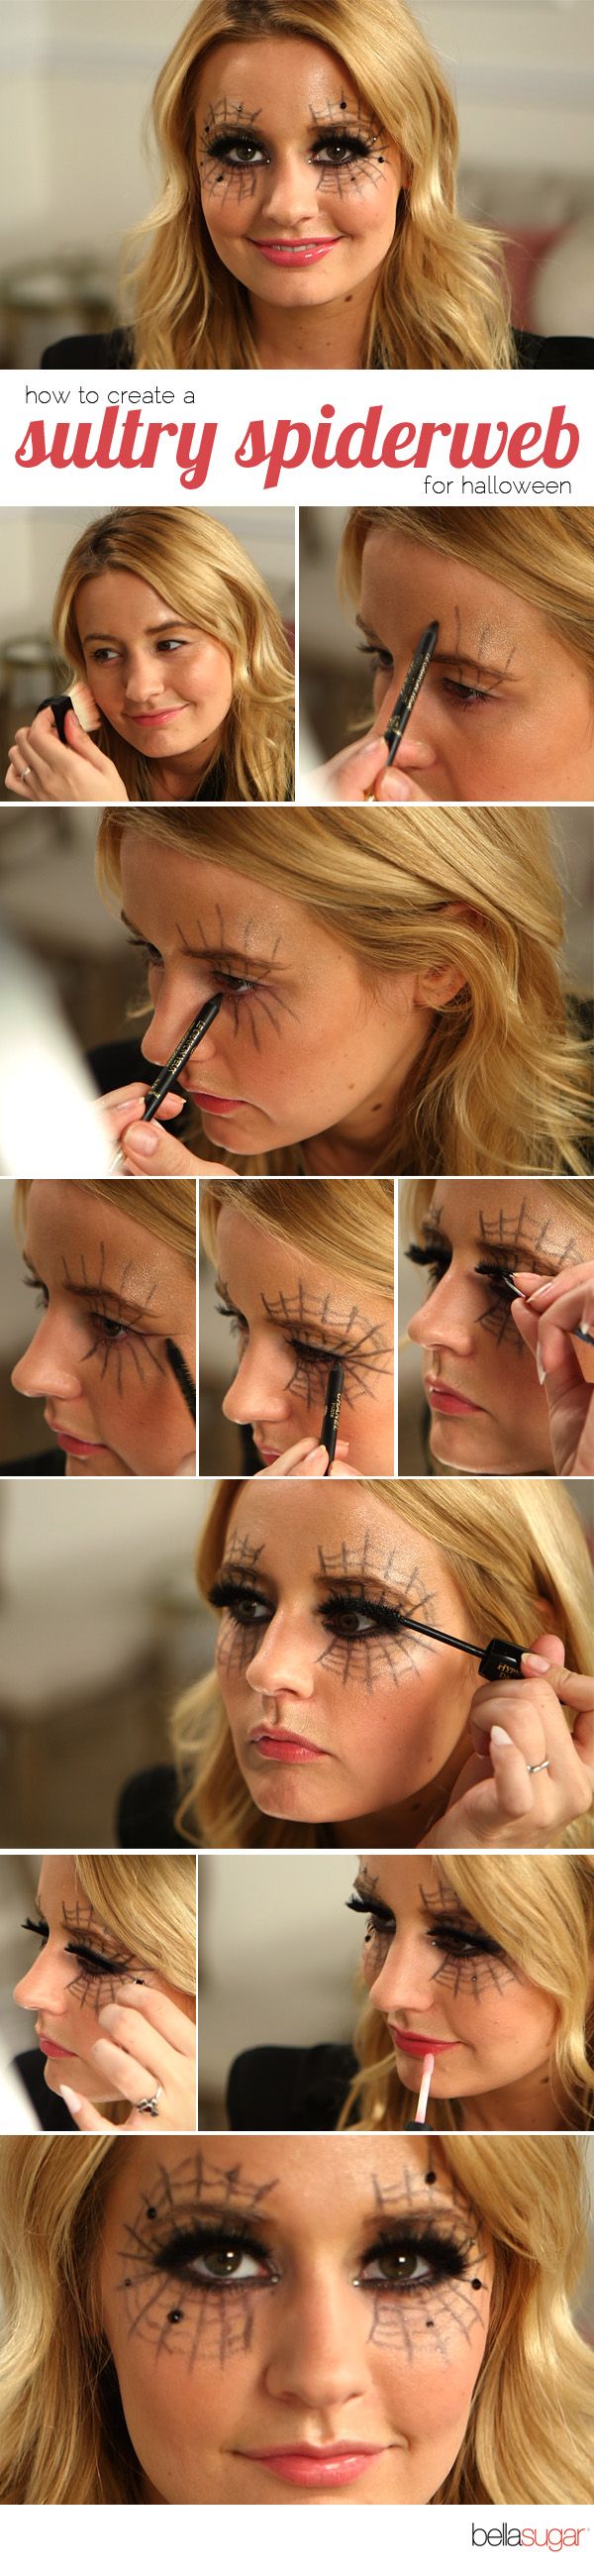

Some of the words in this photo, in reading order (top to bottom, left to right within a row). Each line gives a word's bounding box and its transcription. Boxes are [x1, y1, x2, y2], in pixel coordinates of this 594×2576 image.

[195, 1020, 206, 1030] LE
[178, 1027, 200, 1057] CRAYON
[167, 1055, 183, 1075] YEUX
[333, 1393, 342, 1431] CHANEL
